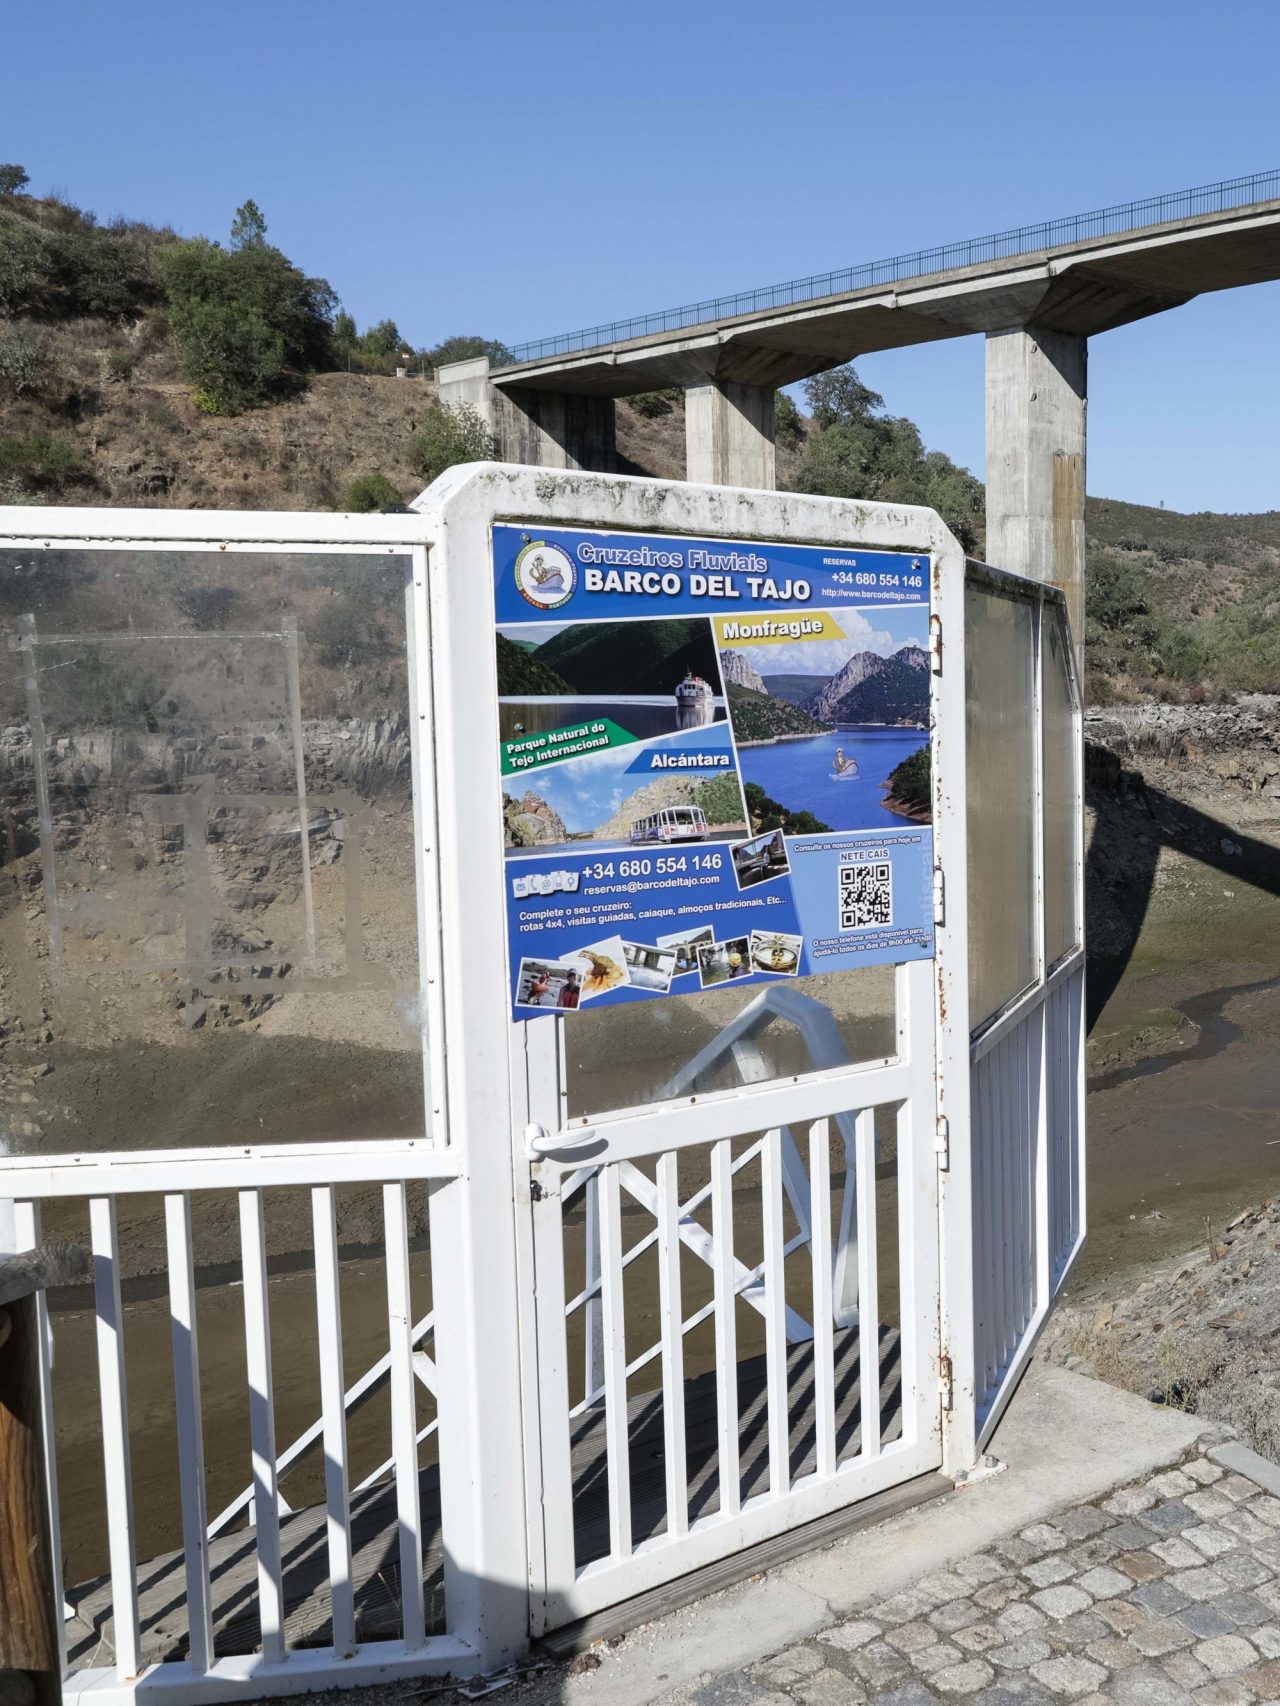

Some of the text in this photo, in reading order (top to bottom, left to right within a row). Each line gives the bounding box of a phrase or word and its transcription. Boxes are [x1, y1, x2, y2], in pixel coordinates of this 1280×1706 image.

[577, 542, 768, 573] Cruzeiros Fluviais
[823, 558, 857, 567] RESERVAS
[584, 569, 811, 600] BARCO DEL TAJO
[832, 572, 922, 588] +34 680 554 146
[549, 592, 573, 609] PORTUGAL
[822, 588, 921, 601] http://www.barcodeltajo.com
[722, 617, 823, 639] Monfragüe
[506, 723, 605, 754] Parque Natural do
[509, 735, 609, 768] Tejo Internacional
[651, 752, 730, 768] Alcántara
[794, 843, 822, 852] Consulte
[855, 839, 883, 848] cruzeiros
[884, 838, 898, 846] para
[898, 836, 911, 845] hoje
[912, 835, 921, 843] em
[841, 849, 889, 861] NETE CAIS
[582, 853, 722, 879] +34 680 554 146
[584, 875, 720, 895] reservas@barcodeltajo.com
[519, 902, 632, 921] Complete o seu cruzeiro:
[520, 896, 787, 932] rotas 4x4, visitas guiadas, caiaque, almoços tradicionais, Etc...
[819, 938, 838, 946] nosso
[839, 934, 864, 944] telefone
[865, 932, 878, 941] está
[879, 929, 909, 939] disponível
[909, 927, 923, 936] para
[813, 948, 838, 957] ajudá-lo
[839, 945, 857, 954] todos
[866, 942, 879, 950] dias
[880, 940, 888, 948] de
[888, 938, 903, 948] 9h00
[904, 936, 914, 945] até
